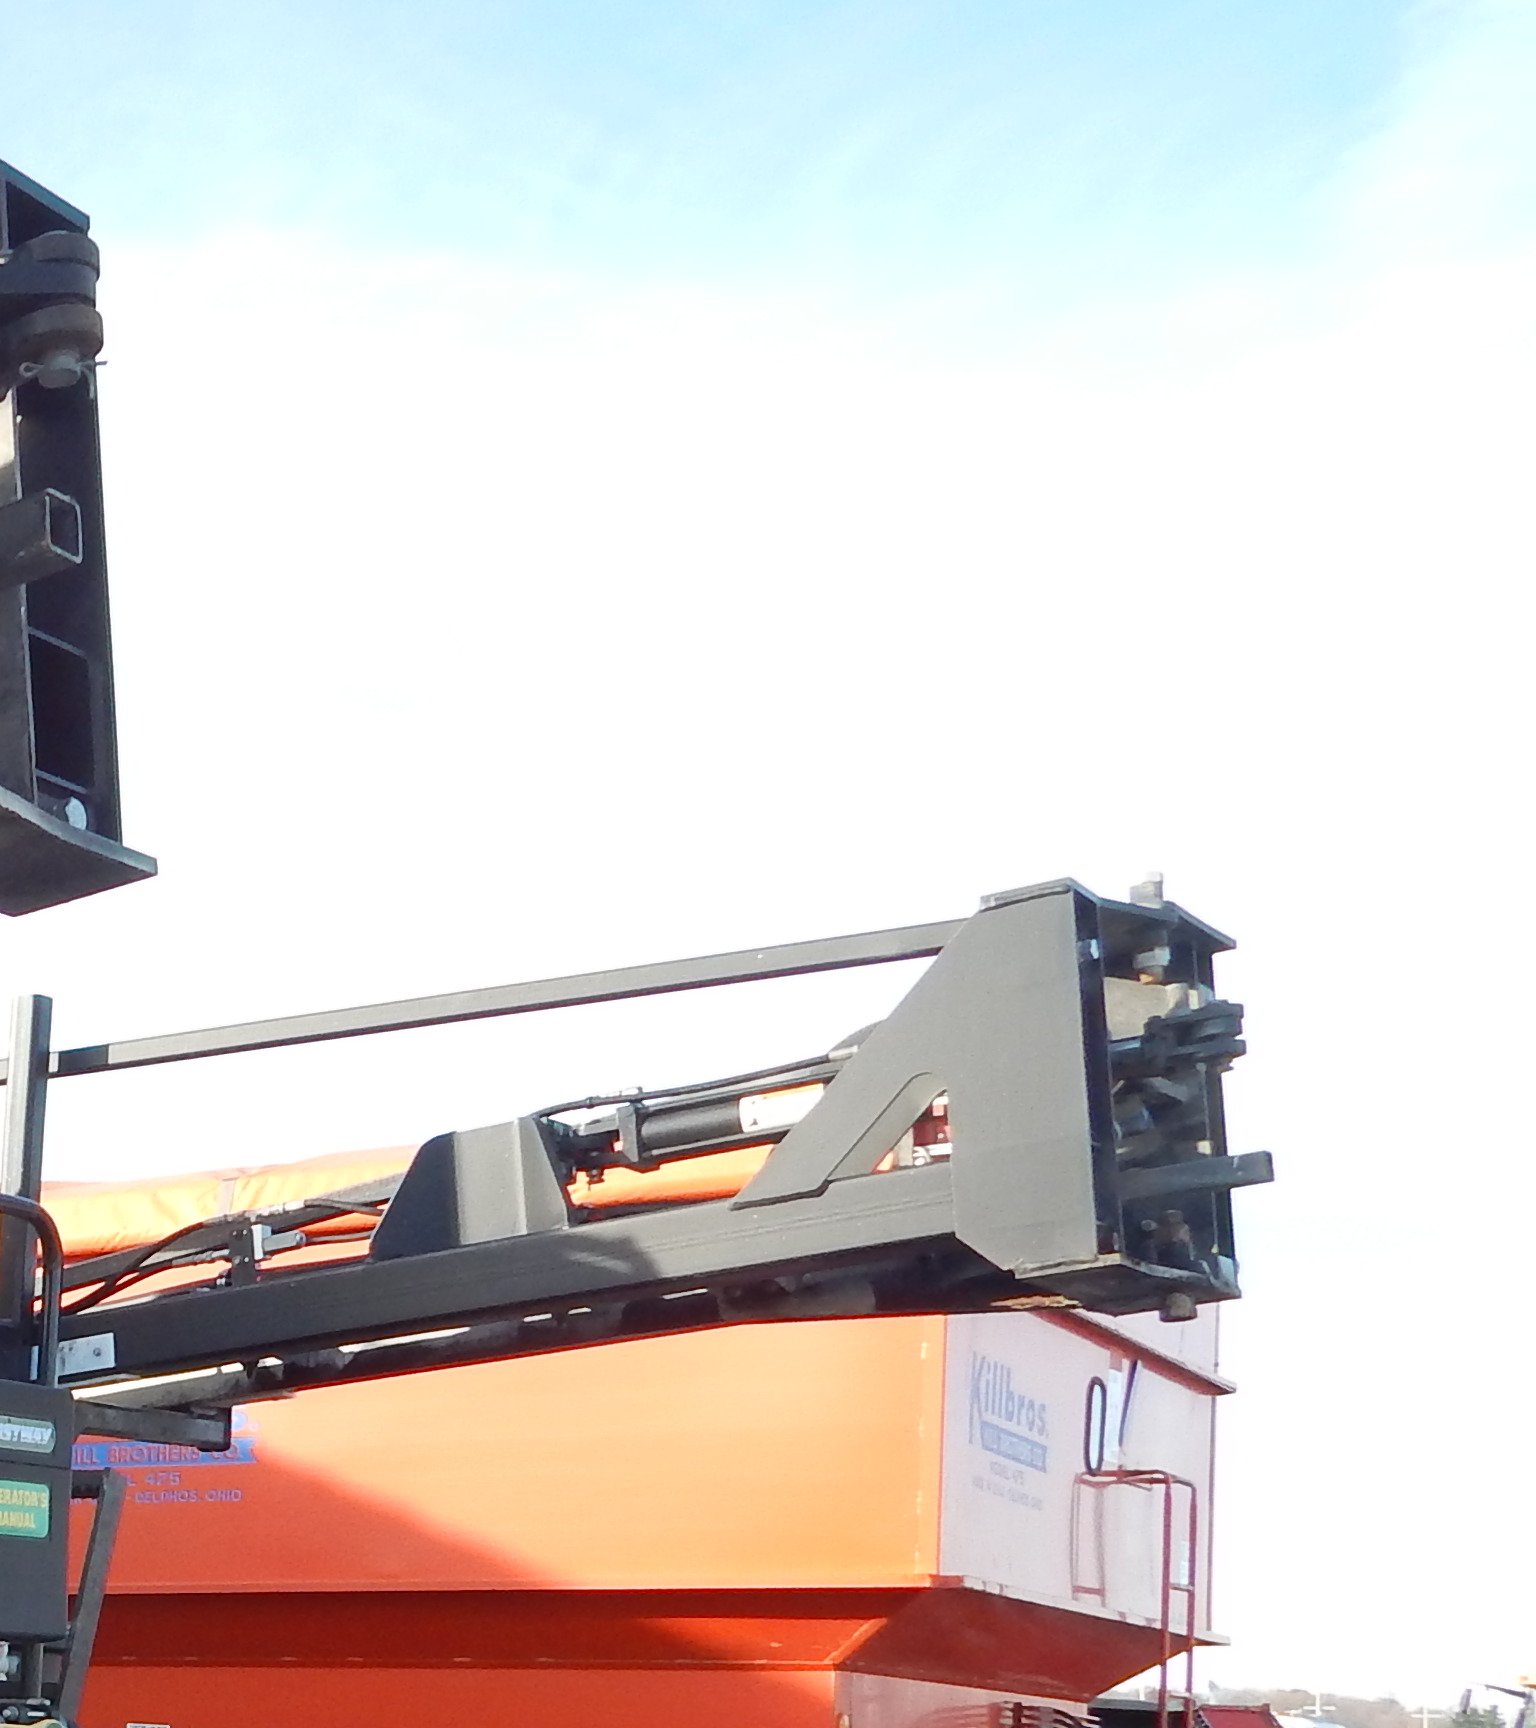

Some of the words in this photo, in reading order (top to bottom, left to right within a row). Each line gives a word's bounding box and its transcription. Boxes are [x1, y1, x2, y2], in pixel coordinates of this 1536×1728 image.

[74, 1446, 100, 1464] ILL
[108, 1444, 200, 1463] BROTHERS
[145, 1472, 181, 1487] 475
[205, 1489, 243, 1502] OHIO
